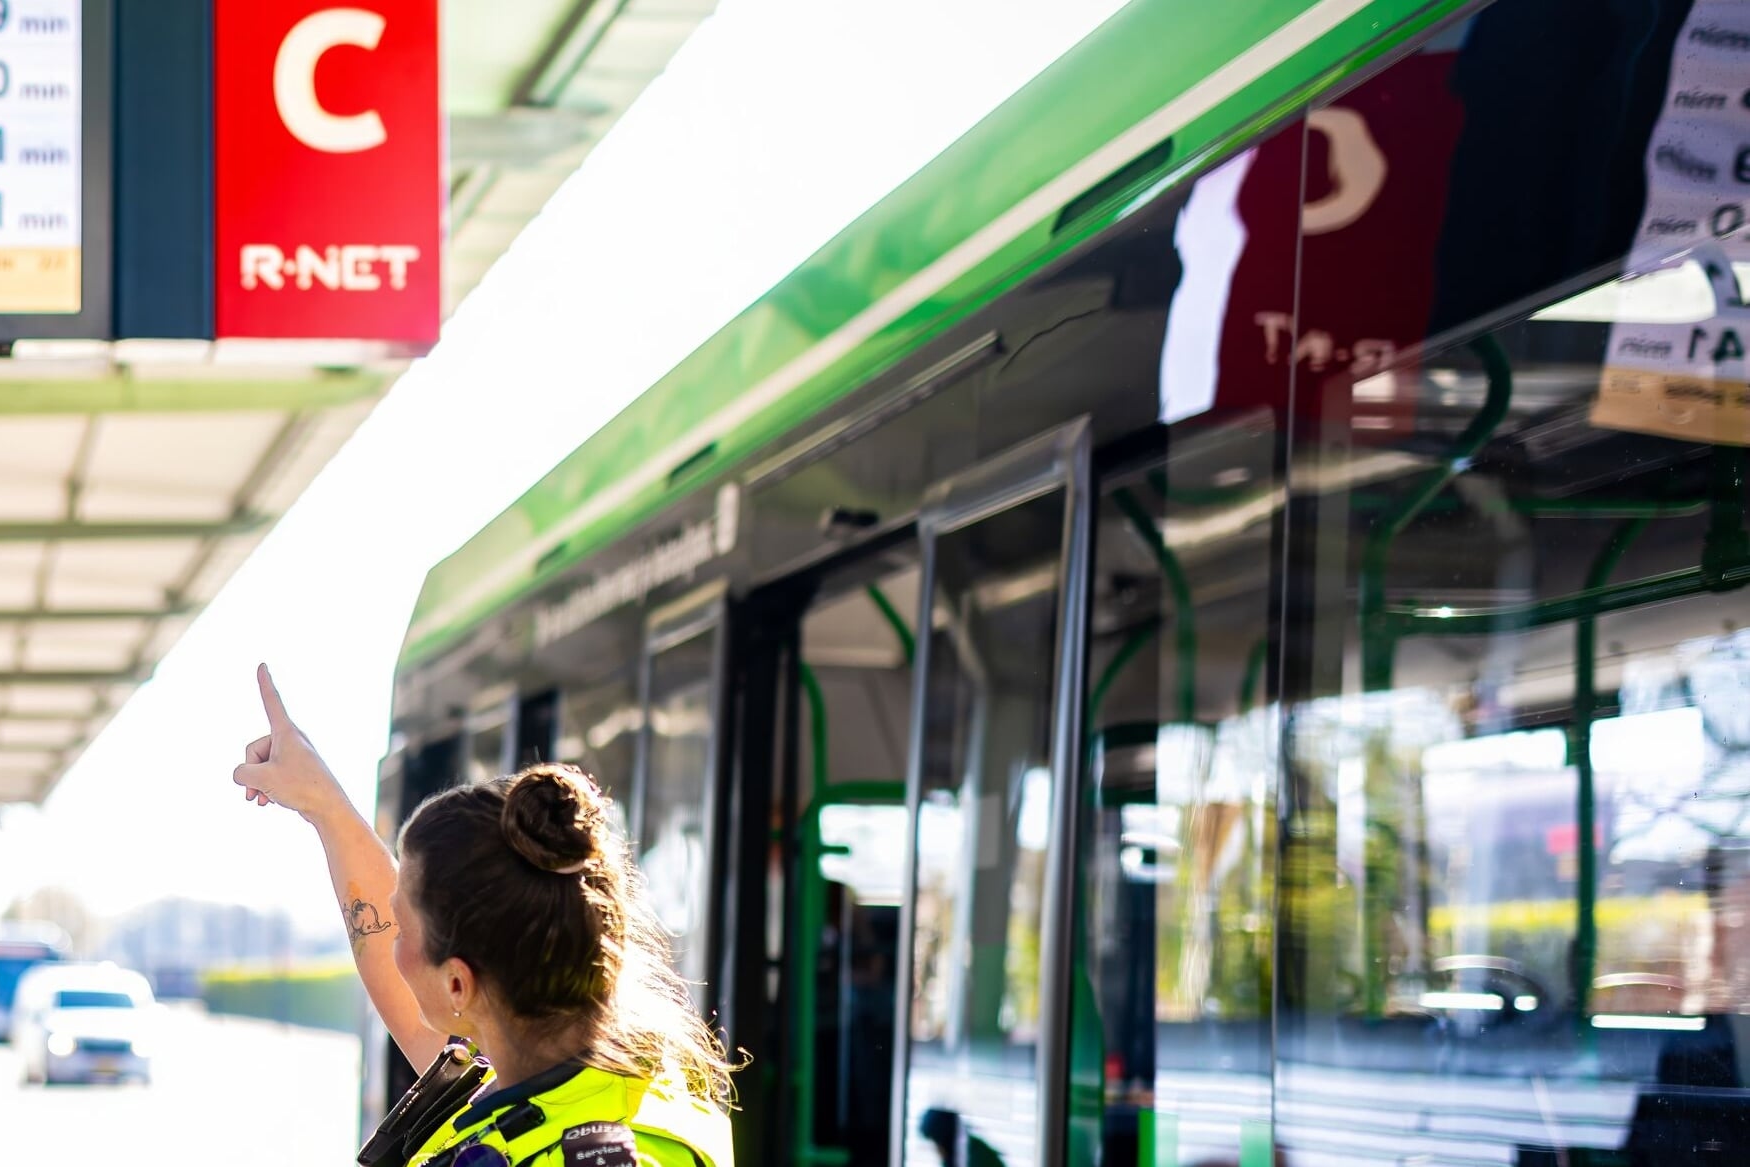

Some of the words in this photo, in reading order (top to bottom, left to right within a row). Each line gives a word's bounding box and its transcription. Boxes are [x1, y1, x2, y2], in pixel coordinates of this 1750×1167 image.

[19, 14, 69, 34] min
[273, 7, 387, 153] C
[19, 81, 69, 100] min
[19, 146, 69, 165] min
[18, 212, 68, 231] min
[576, 1146, 623, 1160] Service
